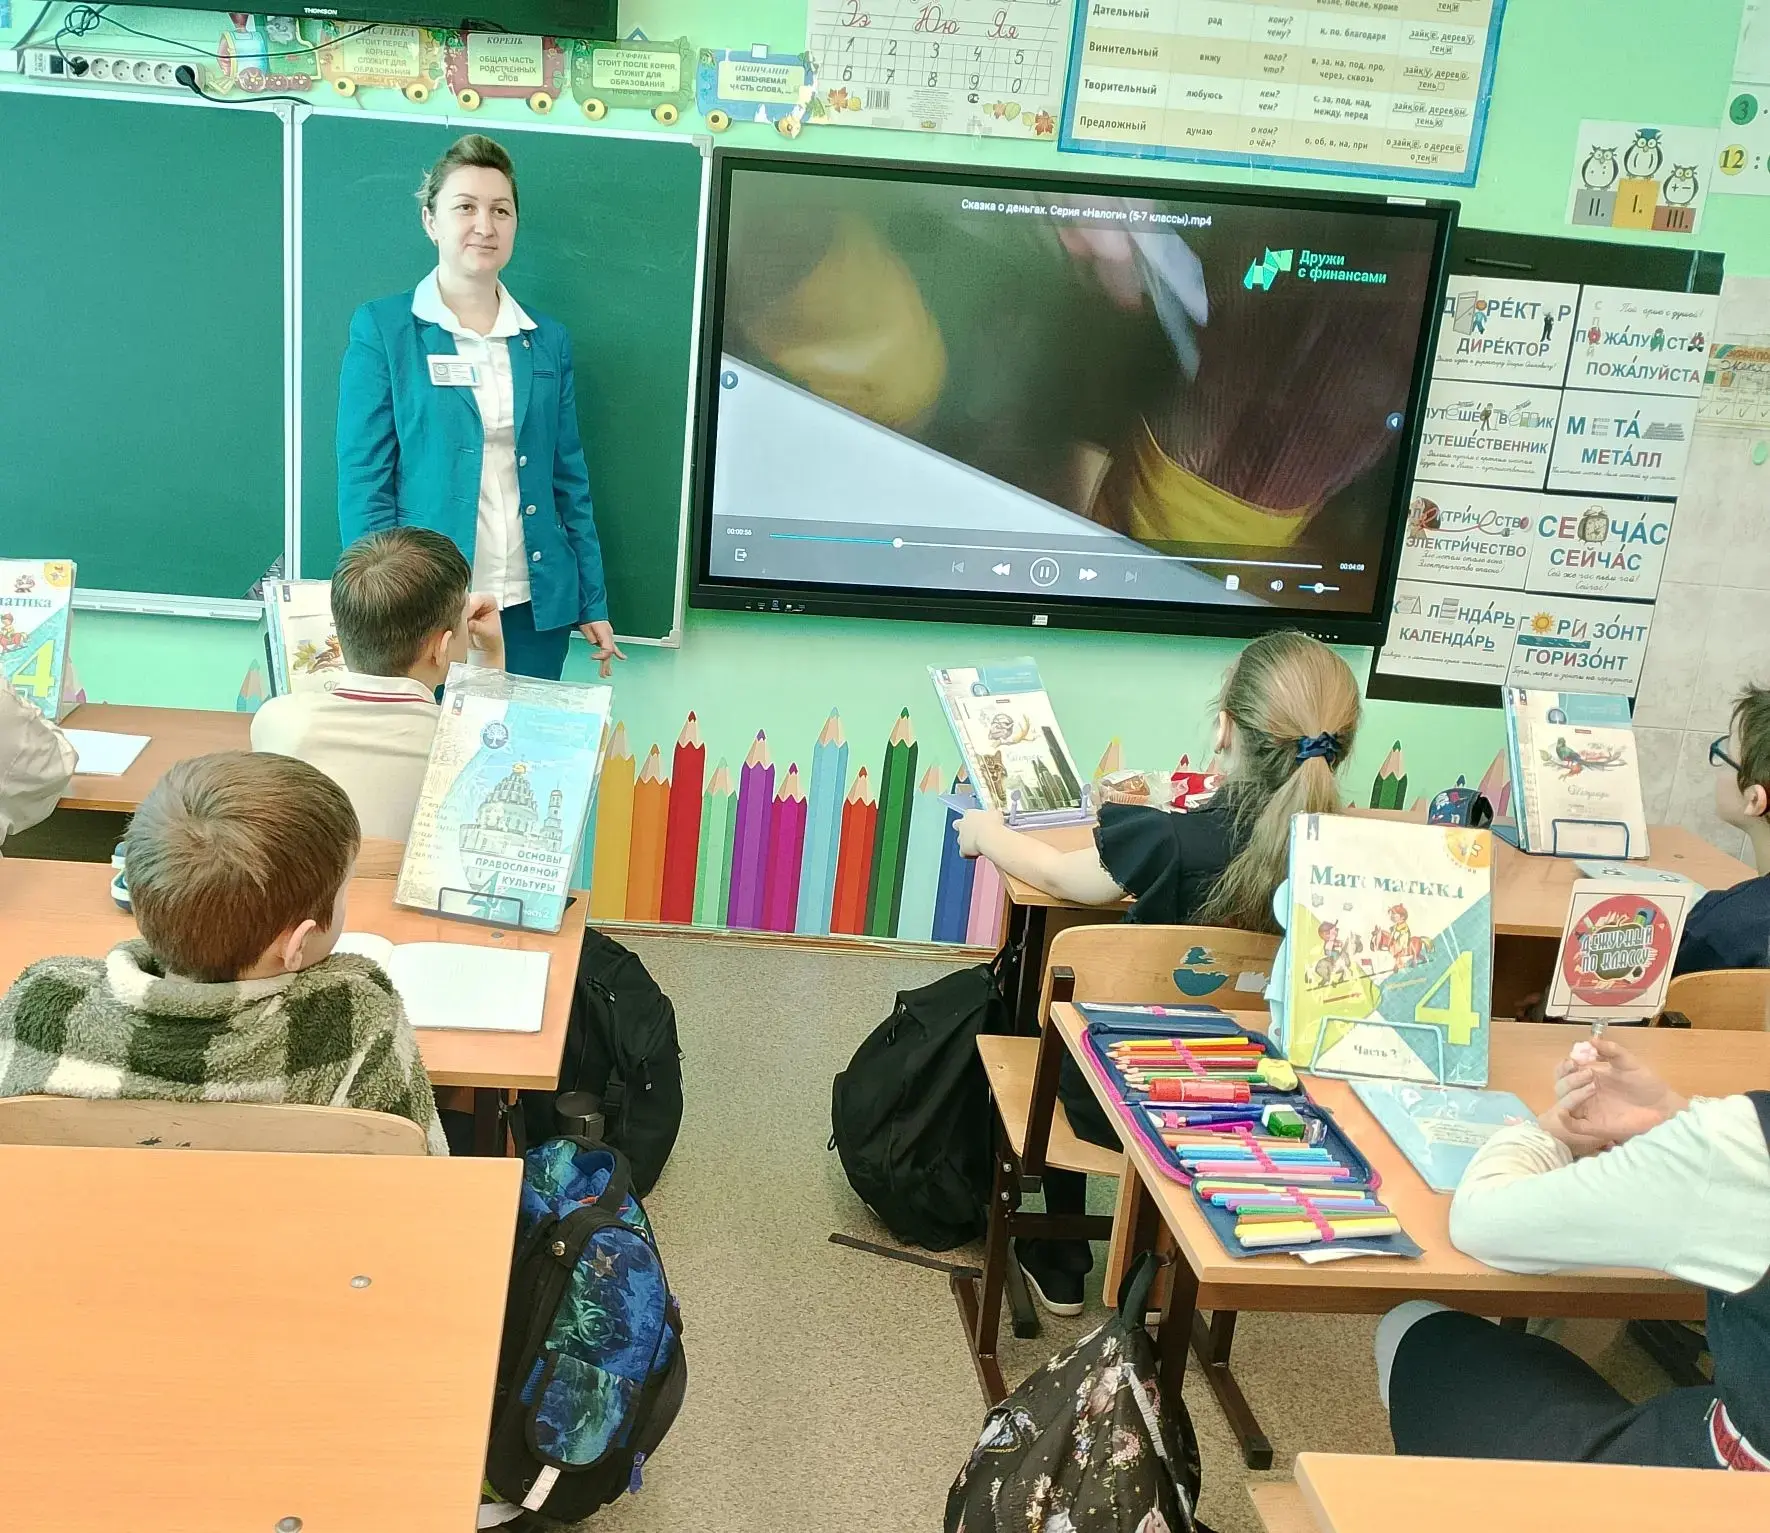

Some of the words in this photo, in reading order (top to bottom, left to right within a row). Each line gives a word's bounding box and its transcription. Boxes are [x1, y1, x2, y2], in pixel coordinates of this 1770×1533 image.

[1092, 3, 1150, 19] Дательный
[1373, 2, 1399, 12] кроме
[914, 5, 961, 35] Юю
[987, 9, 1020, 40] Яя
[1207, 16, 1223, 26] рад
[1268, 16, 1294, 27] кому?
[1267, 29, 1291, 39] чему?
[1344, 28, 1387, 41] благодаря
[487, 36, 523, 45] КОРЕНЬ
[845, 37, 855, 53] 1
[888, 40, 897, 56] 2
[930, 42, 940, 59] 3
[974, 45, 983, 61] 4
[1014, 49, 1025, 64] 5
[1089, 41, 1159, 57] Винительный
[479, 56, 508, 65] ОБЩАЯ
[1199, 54, 1222, 65] вижу
[1263, 53, 1288, 62] кого?
[1263, 66, 1285, 74] что?
[1368, 63, 1385, 72] про,
[614, 69, 645, 77] СЛУЖИТ
[645, 71, 662, 79] ДЛЯ
[1320, 72, 1345, 81] через,
[1347, 74, 1375, 83] сквозь
[610, 79, 665, 88] ОБРАЗОВАНИЯ
[736, 75, 787, 85] ИЗМЕНЯЕМАЯ
[842, 66, 853, 82] 6
[885, 68, 896, 85] 7
[927, 71, 938, 88] 8
[969, 74, 980, 91] 9
[1011, 78, 1022, 94] 0
[730, 84, 755, 92] ЧАСТЬ
[1084, 79, 1158, 95] Творительный
[1186, 89, 1223, 101] любуюсь
[1260, 90, 1281, 99] кем?
[1258, 103, 1278, 111] чем?
[1736, 100, 1749, 120] 3
[1344, 110, 1369, 120] перед
[1079, 115, 1147, 131] Предложный
[1186, 127, 1213, 137] думаю
[1258, 127, 1279, 136] ком?
[1256, 139, 1276, 148] чём?
[1339, 140, 1351, 148] на,
[1353, 141, 1368, 150] при
[1720, 149, 1745, 169] 12
[961, 198, 996, 211] Сказка
[997, 203, 1005, 212] о
[1005, 204, 1048, 215] деньгах.
[1050, 205, 1080, 218] Серия
[1082, 207, 1127, 220] «Налоги»
[1129, 210, 1148, 223] (5-7
[1149, 213, 1212, 227] классы).mp4
[1299, 250, 1345, 267] Дружи
[1298, 268, 1307, 278] с
[1309, 266, 1387, 284] финансами
[11, 639, 56, 698] 4
[517, 850, 562, 864] ОСНОВЫ
[475, 857, 559, 878] ПРАВОСЛАВНОЙ
[501, 875, 556, 892] КУЛЬТУРЫ
[1580, 953, 1599, 974] ПО
[1600, 948, 1651, 971] КЛАССУ
[1415, 951, 1480, 1046] 4
